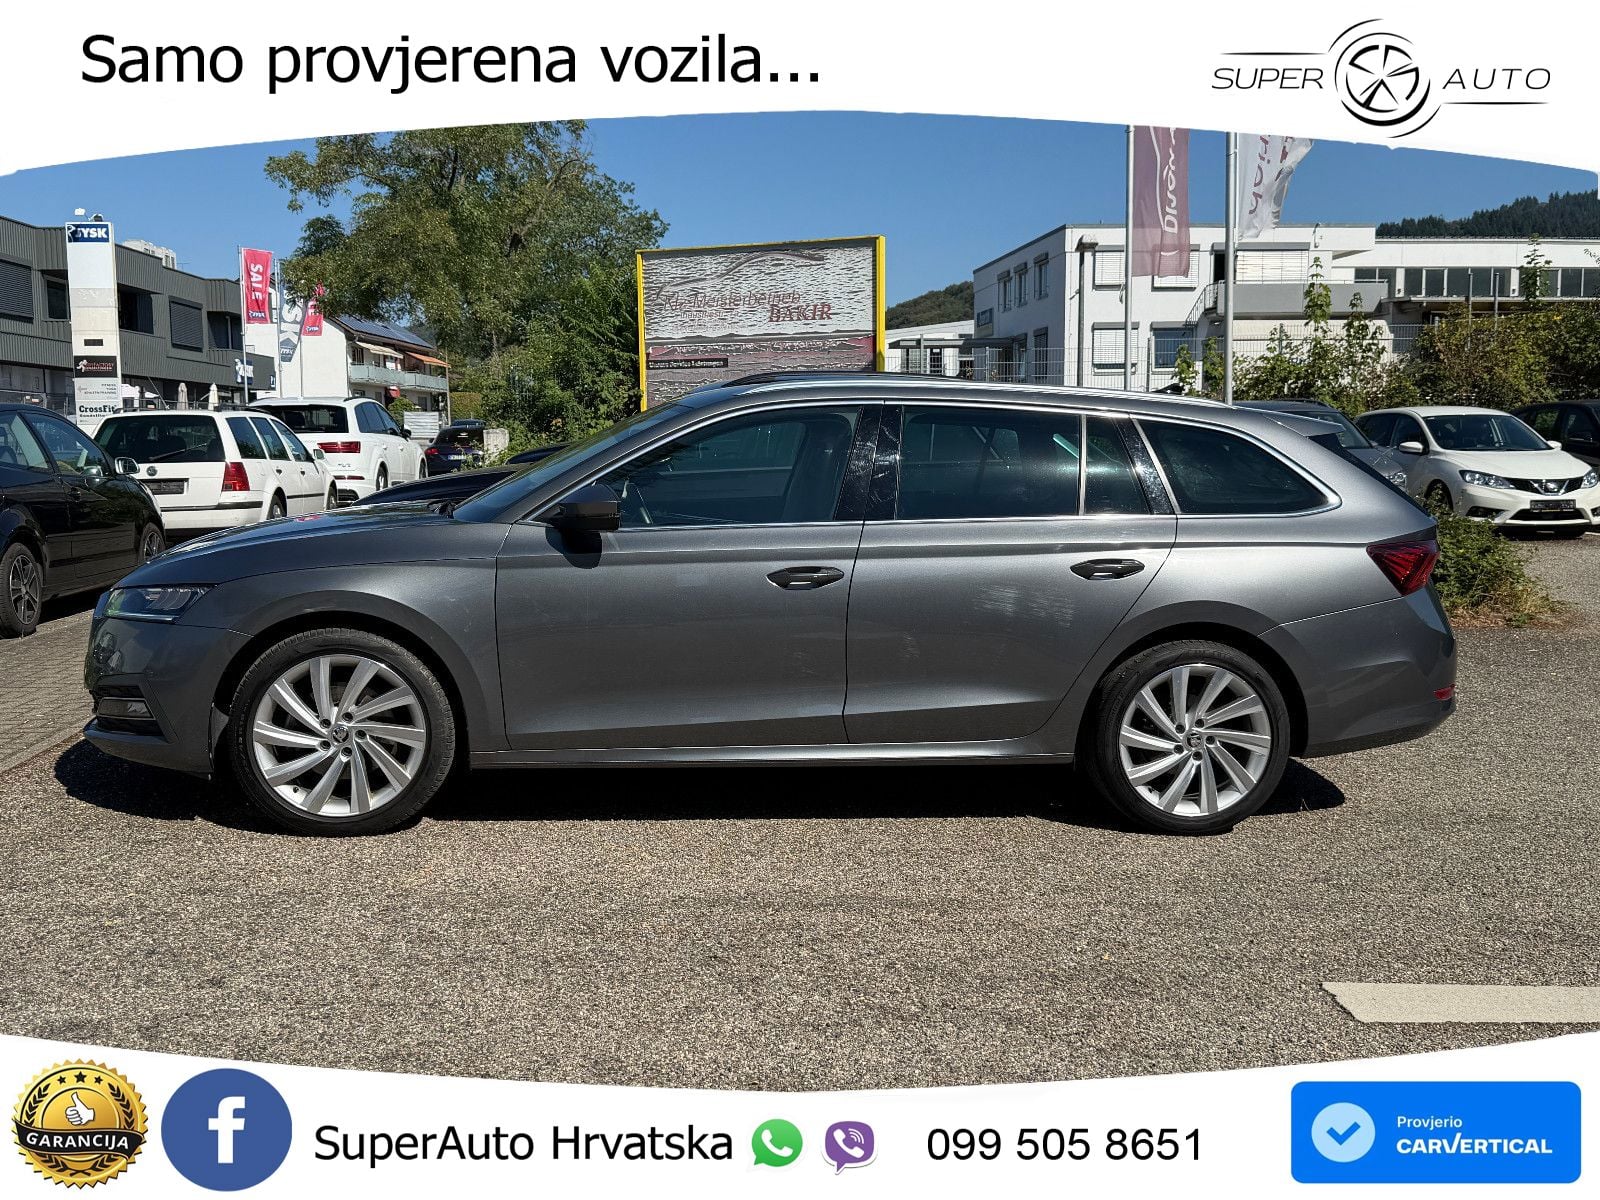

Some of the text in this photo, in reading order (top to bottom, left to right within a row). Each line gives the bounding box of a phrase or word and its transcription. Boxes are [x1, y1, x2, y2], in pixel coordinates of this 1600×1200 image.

[75, 227, 108, 239] JYSK
[250, 262, 264, 301] SALE
[768, 303, 832, 322] BAKIR
[79, 405, 115, 413] CrossFit
